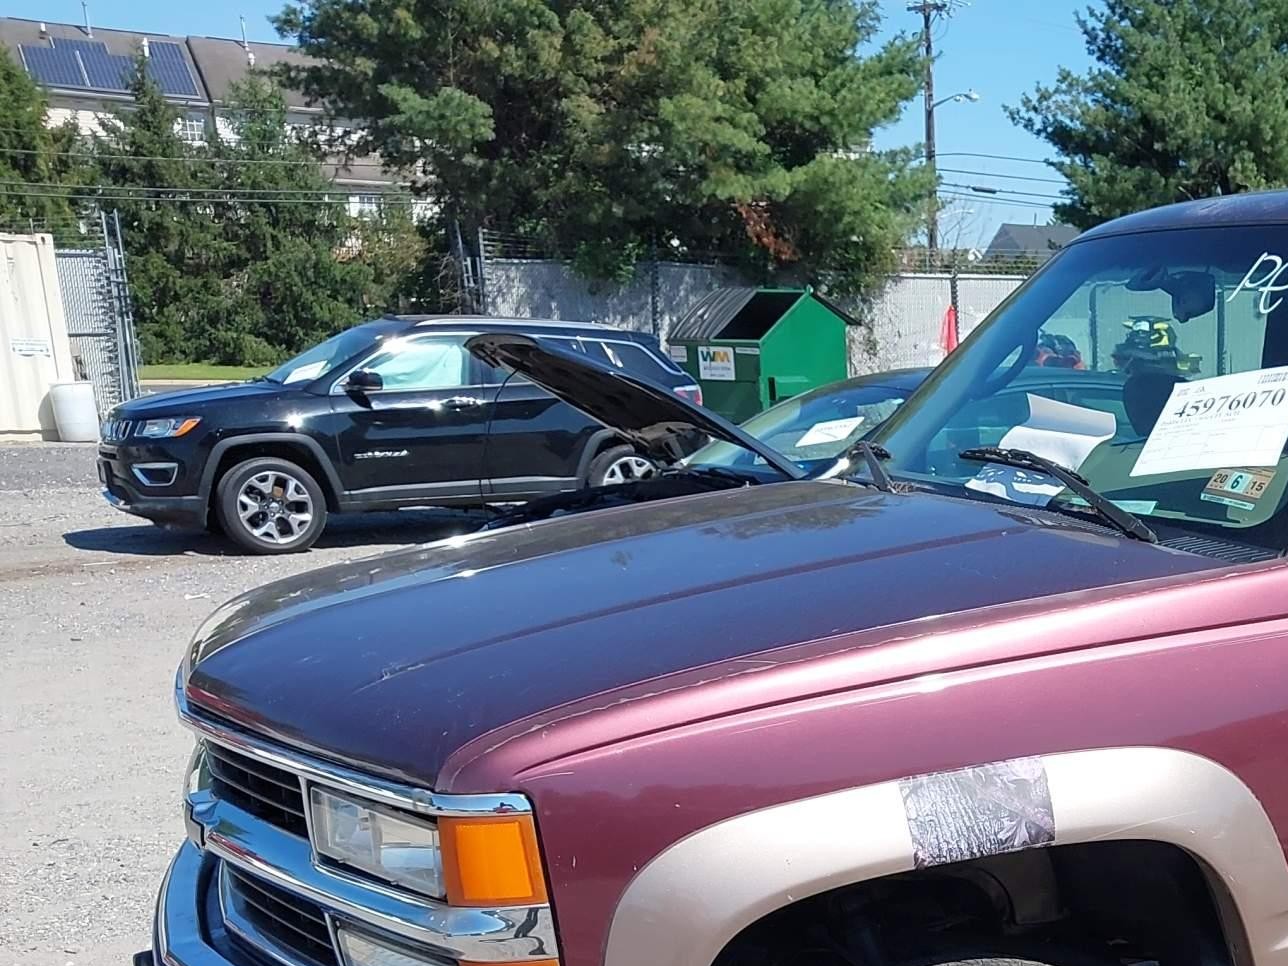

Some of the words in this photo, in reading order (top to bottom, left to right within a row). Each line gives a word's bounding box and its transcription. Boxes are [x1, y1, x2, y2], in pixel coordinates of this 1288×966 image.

[701, 351, 730, 363] WM
[1174, 388, 1287, 418] 45976070
[1214, 474, 1228, 483] 20
[1231, 475, 1243, 489] 6
[1250, 481, 1266, 491] 15
